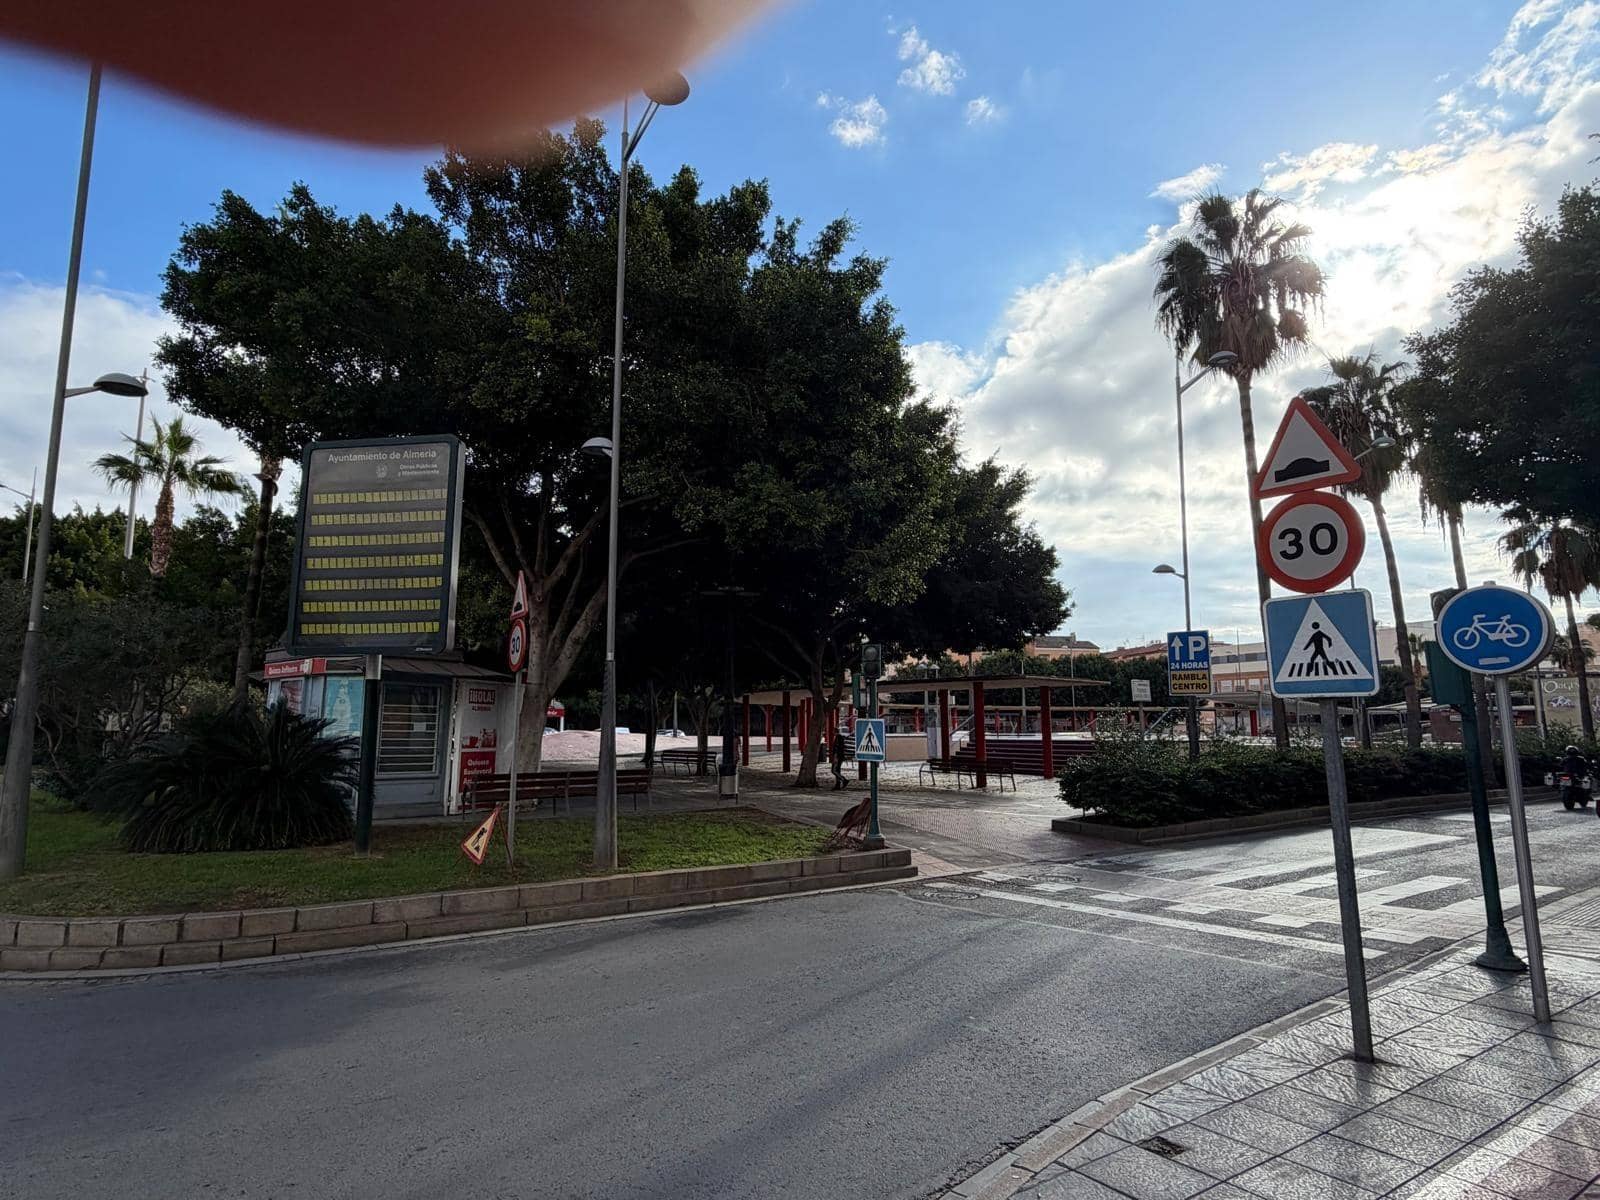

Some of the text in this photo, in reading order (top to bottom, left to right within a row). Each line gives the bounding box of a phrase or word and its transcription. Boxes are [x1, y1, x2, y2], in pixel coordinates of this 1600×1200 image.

[328, 452, 388, 463] Ayuntamiento
[389, 451, 401, 460] de
[1278, 522, 1338, 560] 30
[512, 635, 520, 655] 30
[1188, 635, 1206, 661] P
[1182, 661, 1208, 669] HORAS
[1171, 673, 1208, 681] RAMBLA
[1172, 682, 1208, 690] CENTRO
